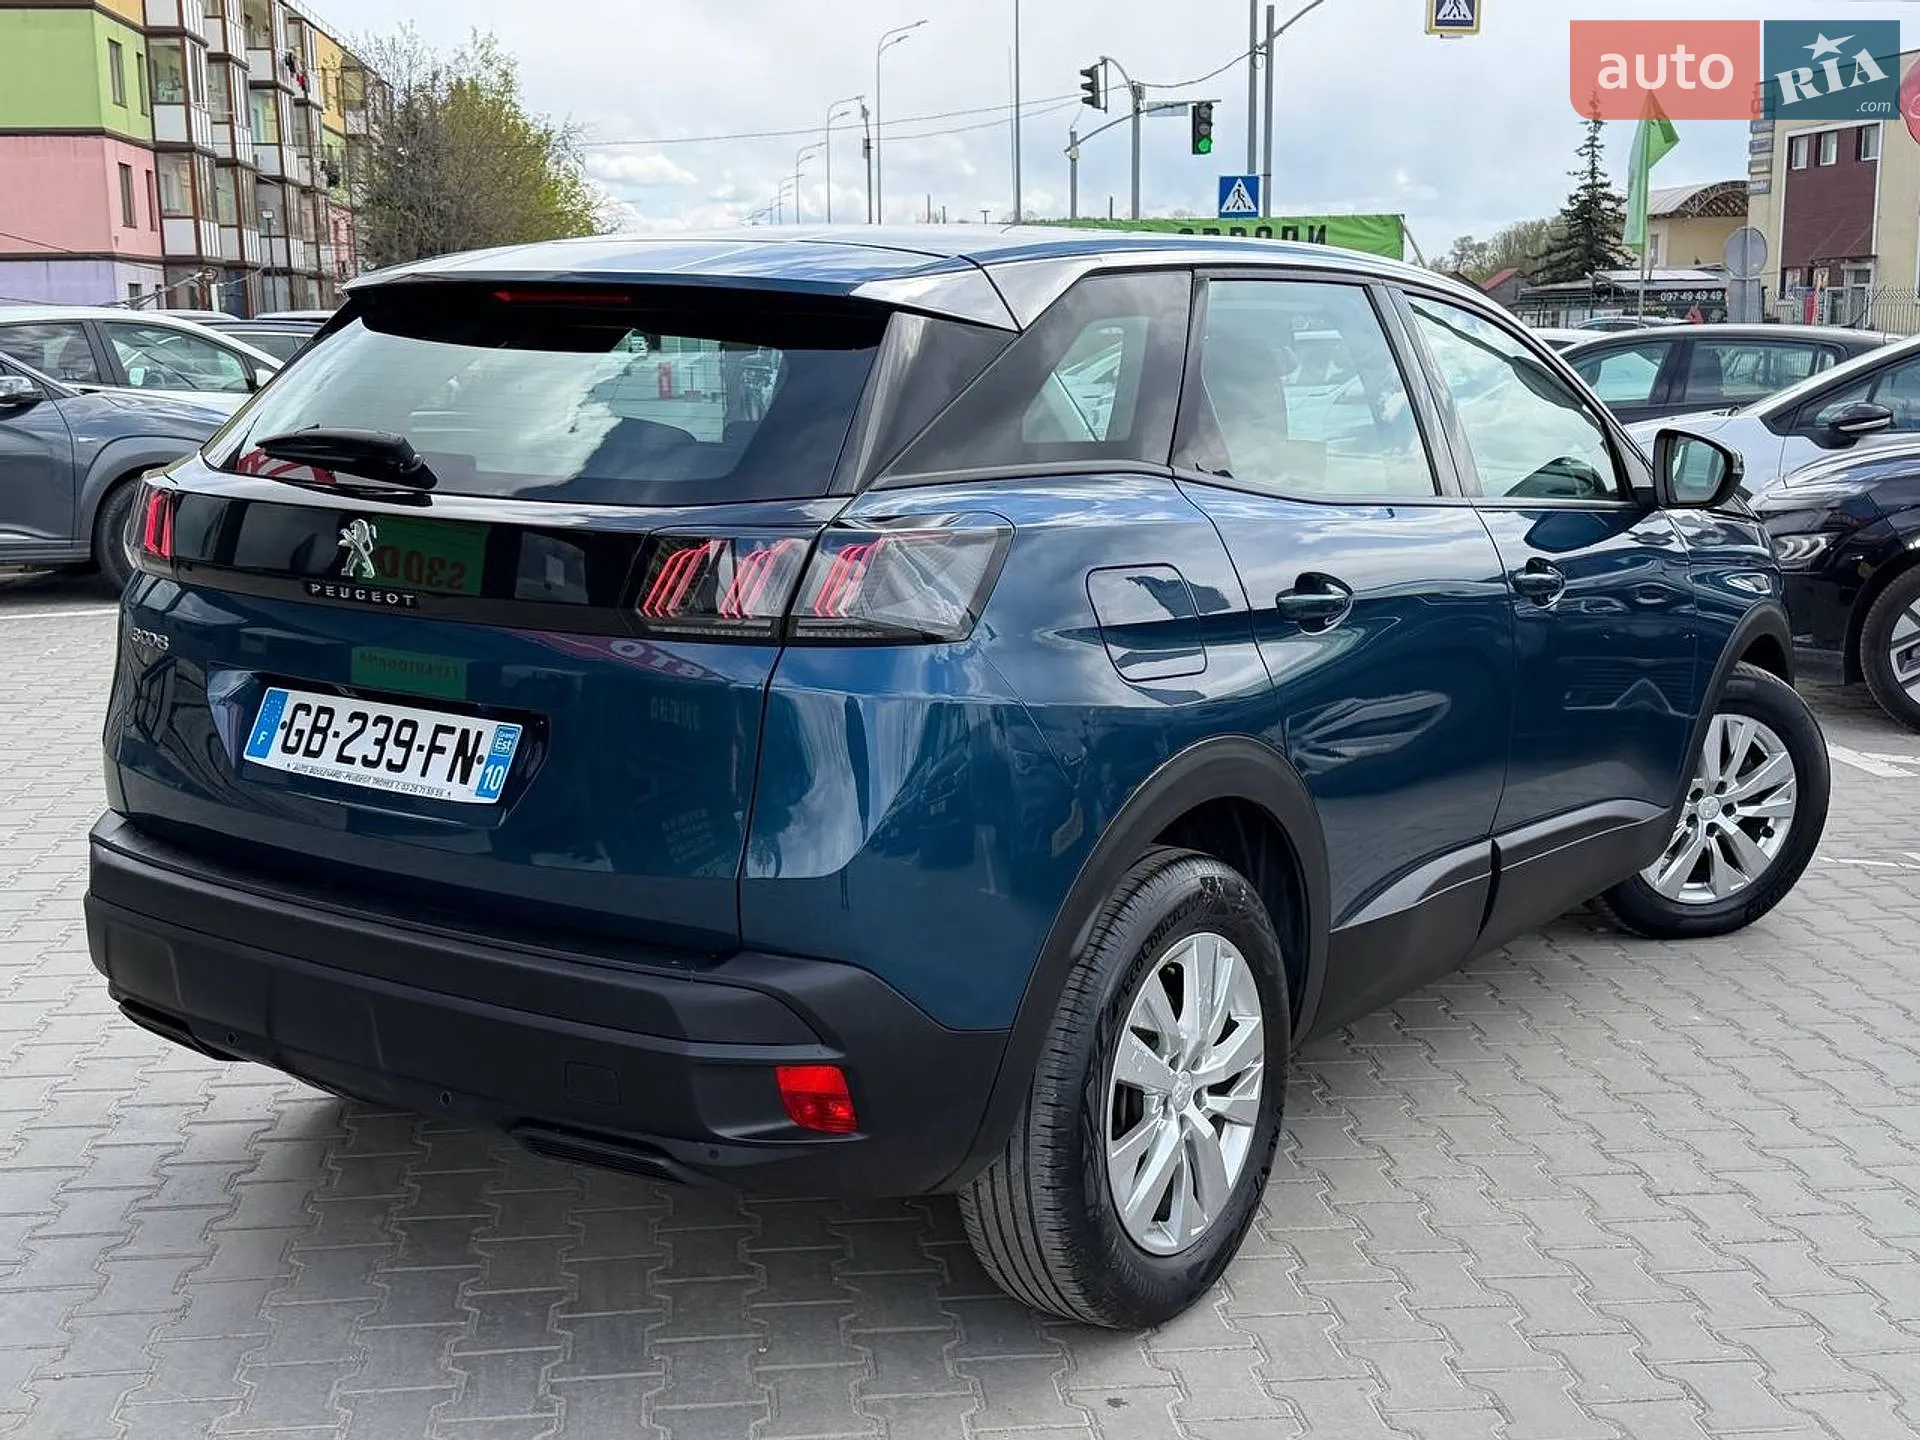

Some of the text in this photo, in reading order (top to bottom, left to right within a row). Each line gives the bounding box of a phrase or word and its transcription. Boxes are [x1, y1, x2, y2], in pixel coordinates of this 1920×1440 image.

[1179, 225, 1326, 245] ОПИ
[311, 583, 415, 607] PEUGEOT
[256, 731, 267, 745] F
[280, 703, 483, 785] GB-239-FN
[495, 737, 512, 750] Est
[484, 763, 505, 791] 10
